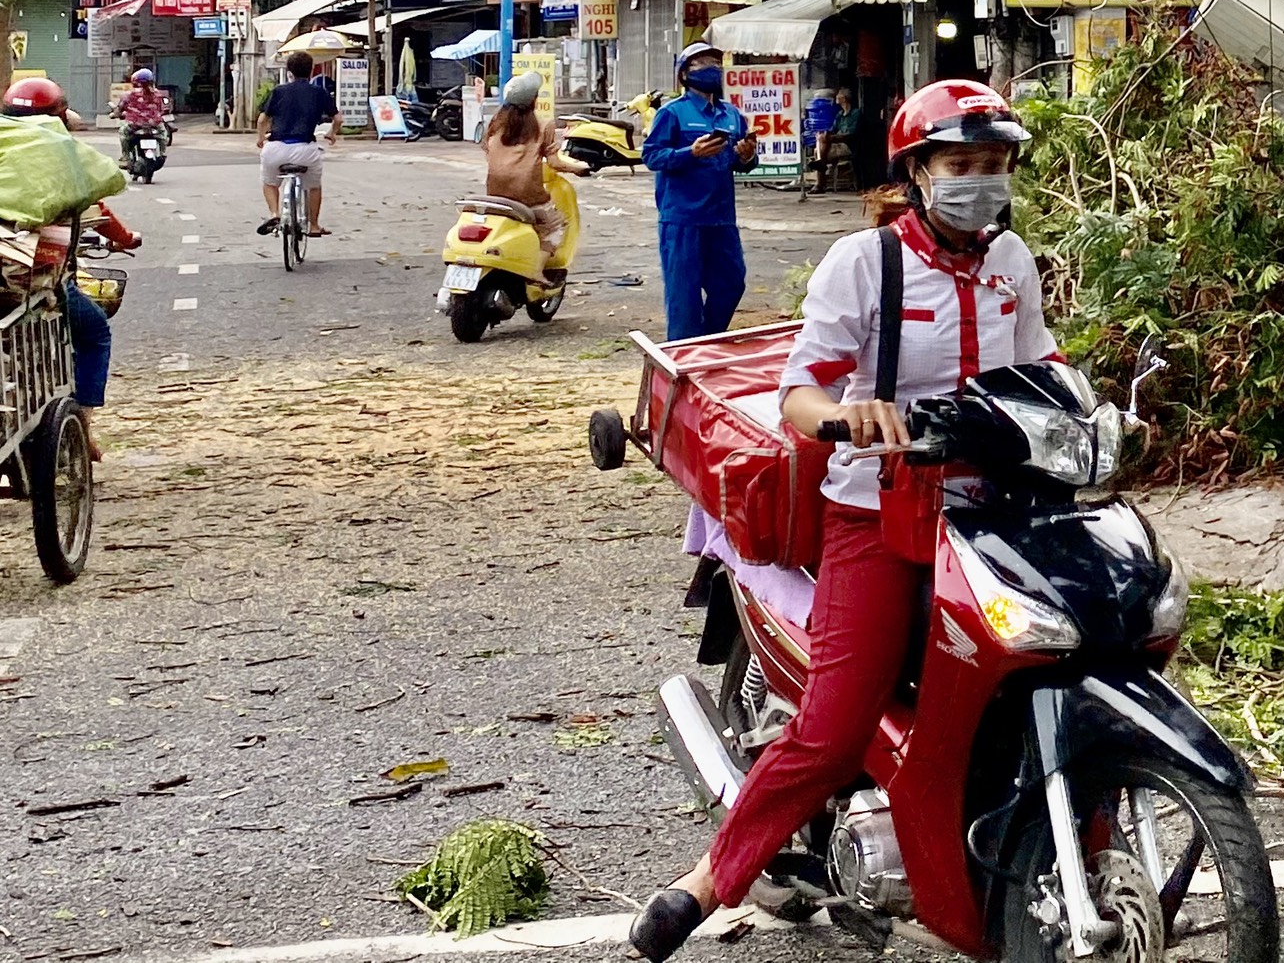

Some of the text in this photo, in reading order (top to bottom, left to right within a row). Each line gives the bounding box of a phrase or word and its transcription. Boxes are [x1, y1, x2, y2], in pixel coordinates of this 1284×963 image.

[585, 19, 614, 35] 105
[342, 60, 368, 70] SALON
[744, 102, 771, 113] MANG
[746, 114, 793, 137] 5k
[936, 639, 980, 668] HONDA
